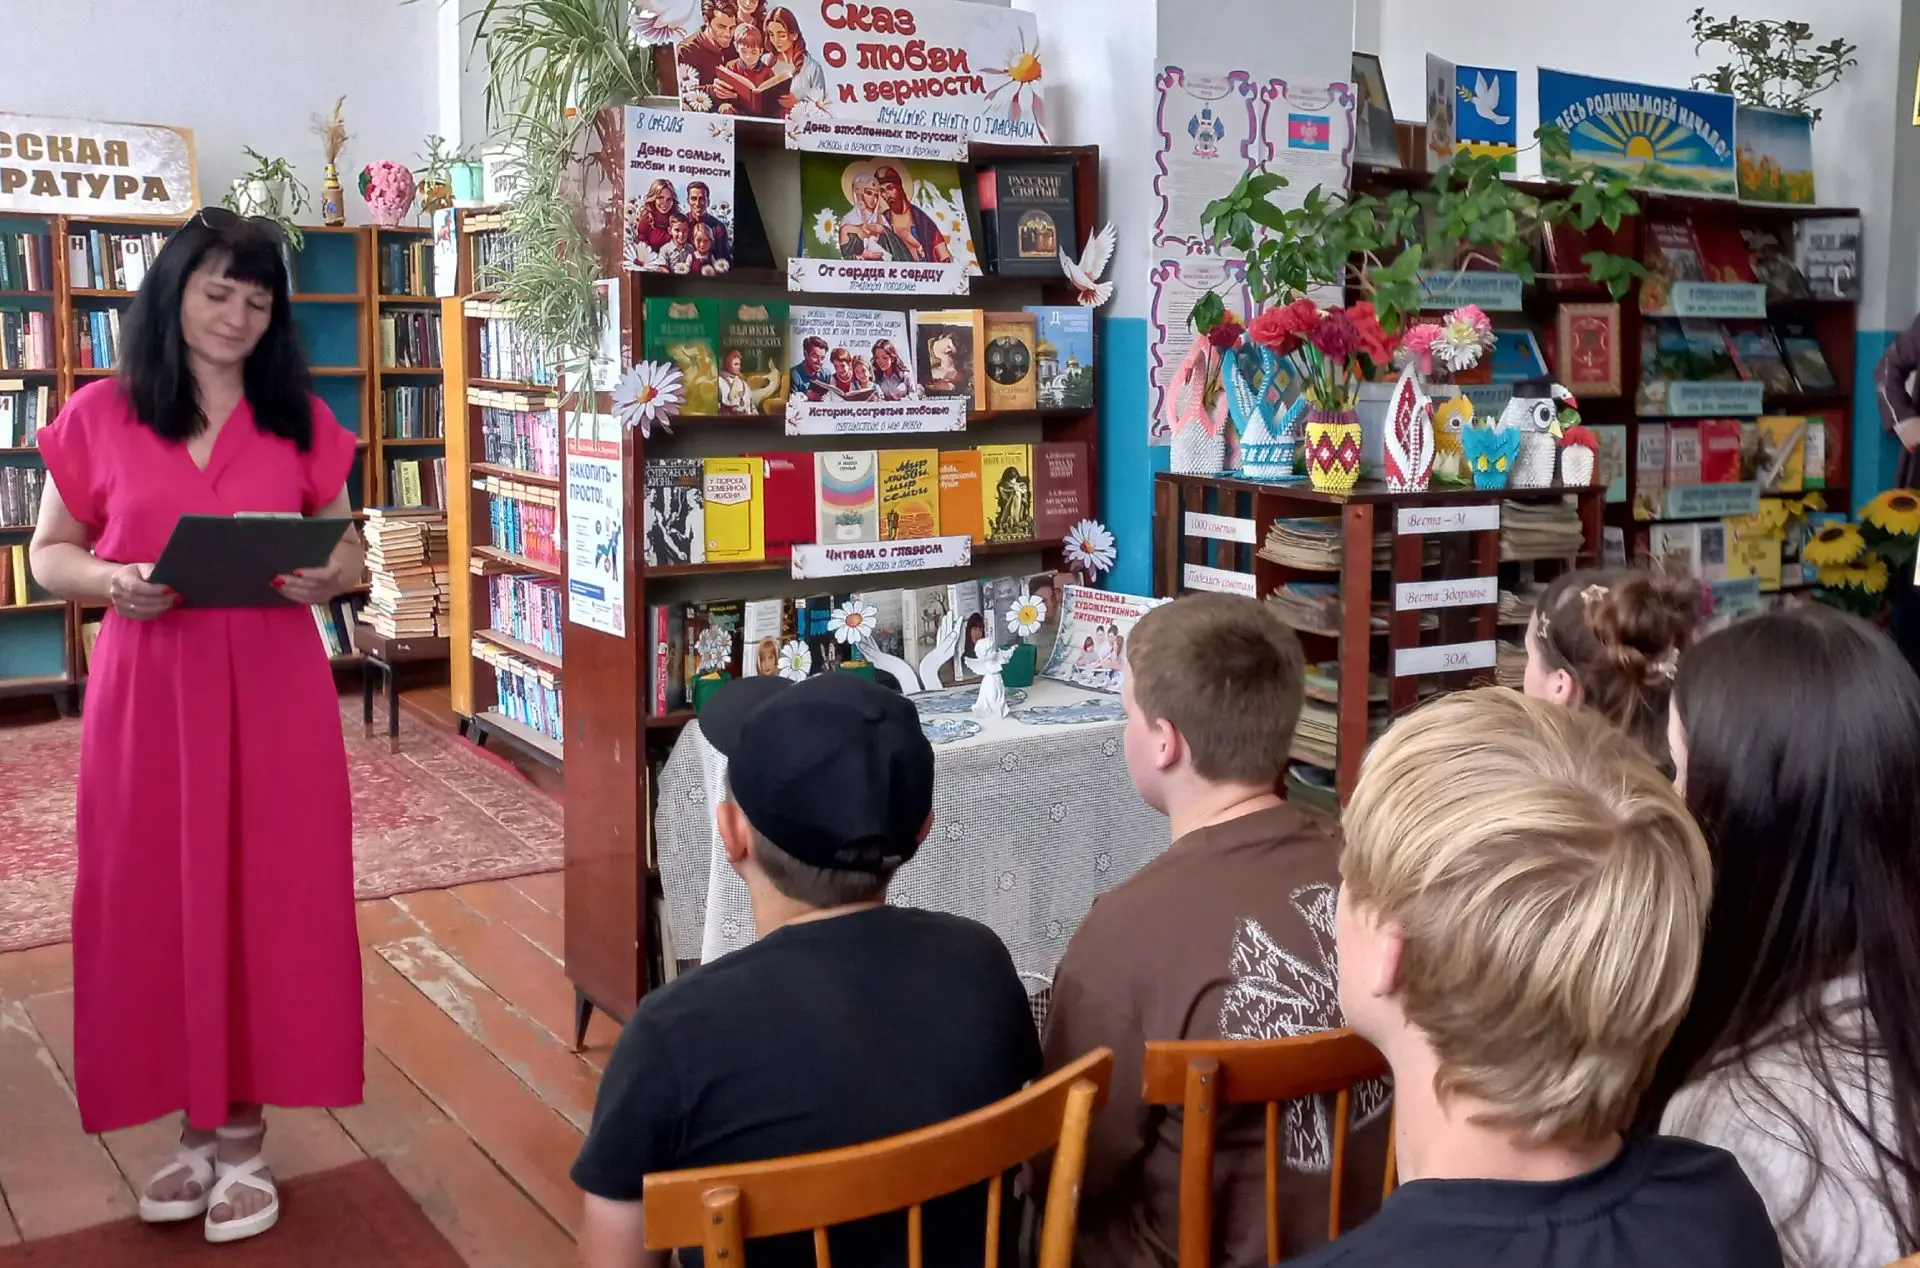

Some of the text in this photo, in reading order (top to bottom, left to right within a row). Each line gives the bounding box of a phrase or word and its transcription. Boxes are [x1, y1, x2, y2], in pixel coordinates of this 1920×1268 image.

[821, 0, 916, 36] Сказ
[823, 40, 971, 74] о любви
[837, 75, 987, 105] и верности
[636, 112, 685, 133] 8 ИЮЛЯ
[877, 106, 927, 127] ЛУЧШИЕ
[932, 111, 969, 130] КНИГИ
[985, 117, 1036, 138] ГЛАВНОМ
[1555, 102, 1586, 135] ДЕСЬ
[1586, 92, 1641, 117] РОДИНЫ
[1642, 94, 1677, 122] МОЕЙ
[803, 121, 958, 143] День влюбленных по-русски
[637, 142, 726, 165] День семьи,
[630, 160, 731, 177] любви и верности
[71, 237, 84, 250] Н
[818, 264, 944, 283] От сердца к сердцу
[906, 404, 950, 416] любовью
[569, 462, 611, 483] НАКОПИТЬ
[646, 467, 697, 478] СУПРУЖЕСКАЯ
[896, 459, 928, 472] Мир
[570, 483, 603, 504] ПРОСТО!
[707, 484, 747, 492] СЕМЕЙНОЙ
[1408, 513, 1441, 527] Веста
[1455, 513, 1466, 525] М
[825, 543, 943, 562] Читаем о главном
[1075, 589, 1093, 598] ТЕМА
[1094, 592, 1119, 602] СЕМЬИ
[1406, 587, 1487, 604] Веста Здоровье
[1443, 653, 1470, 668] ЗОЖ
